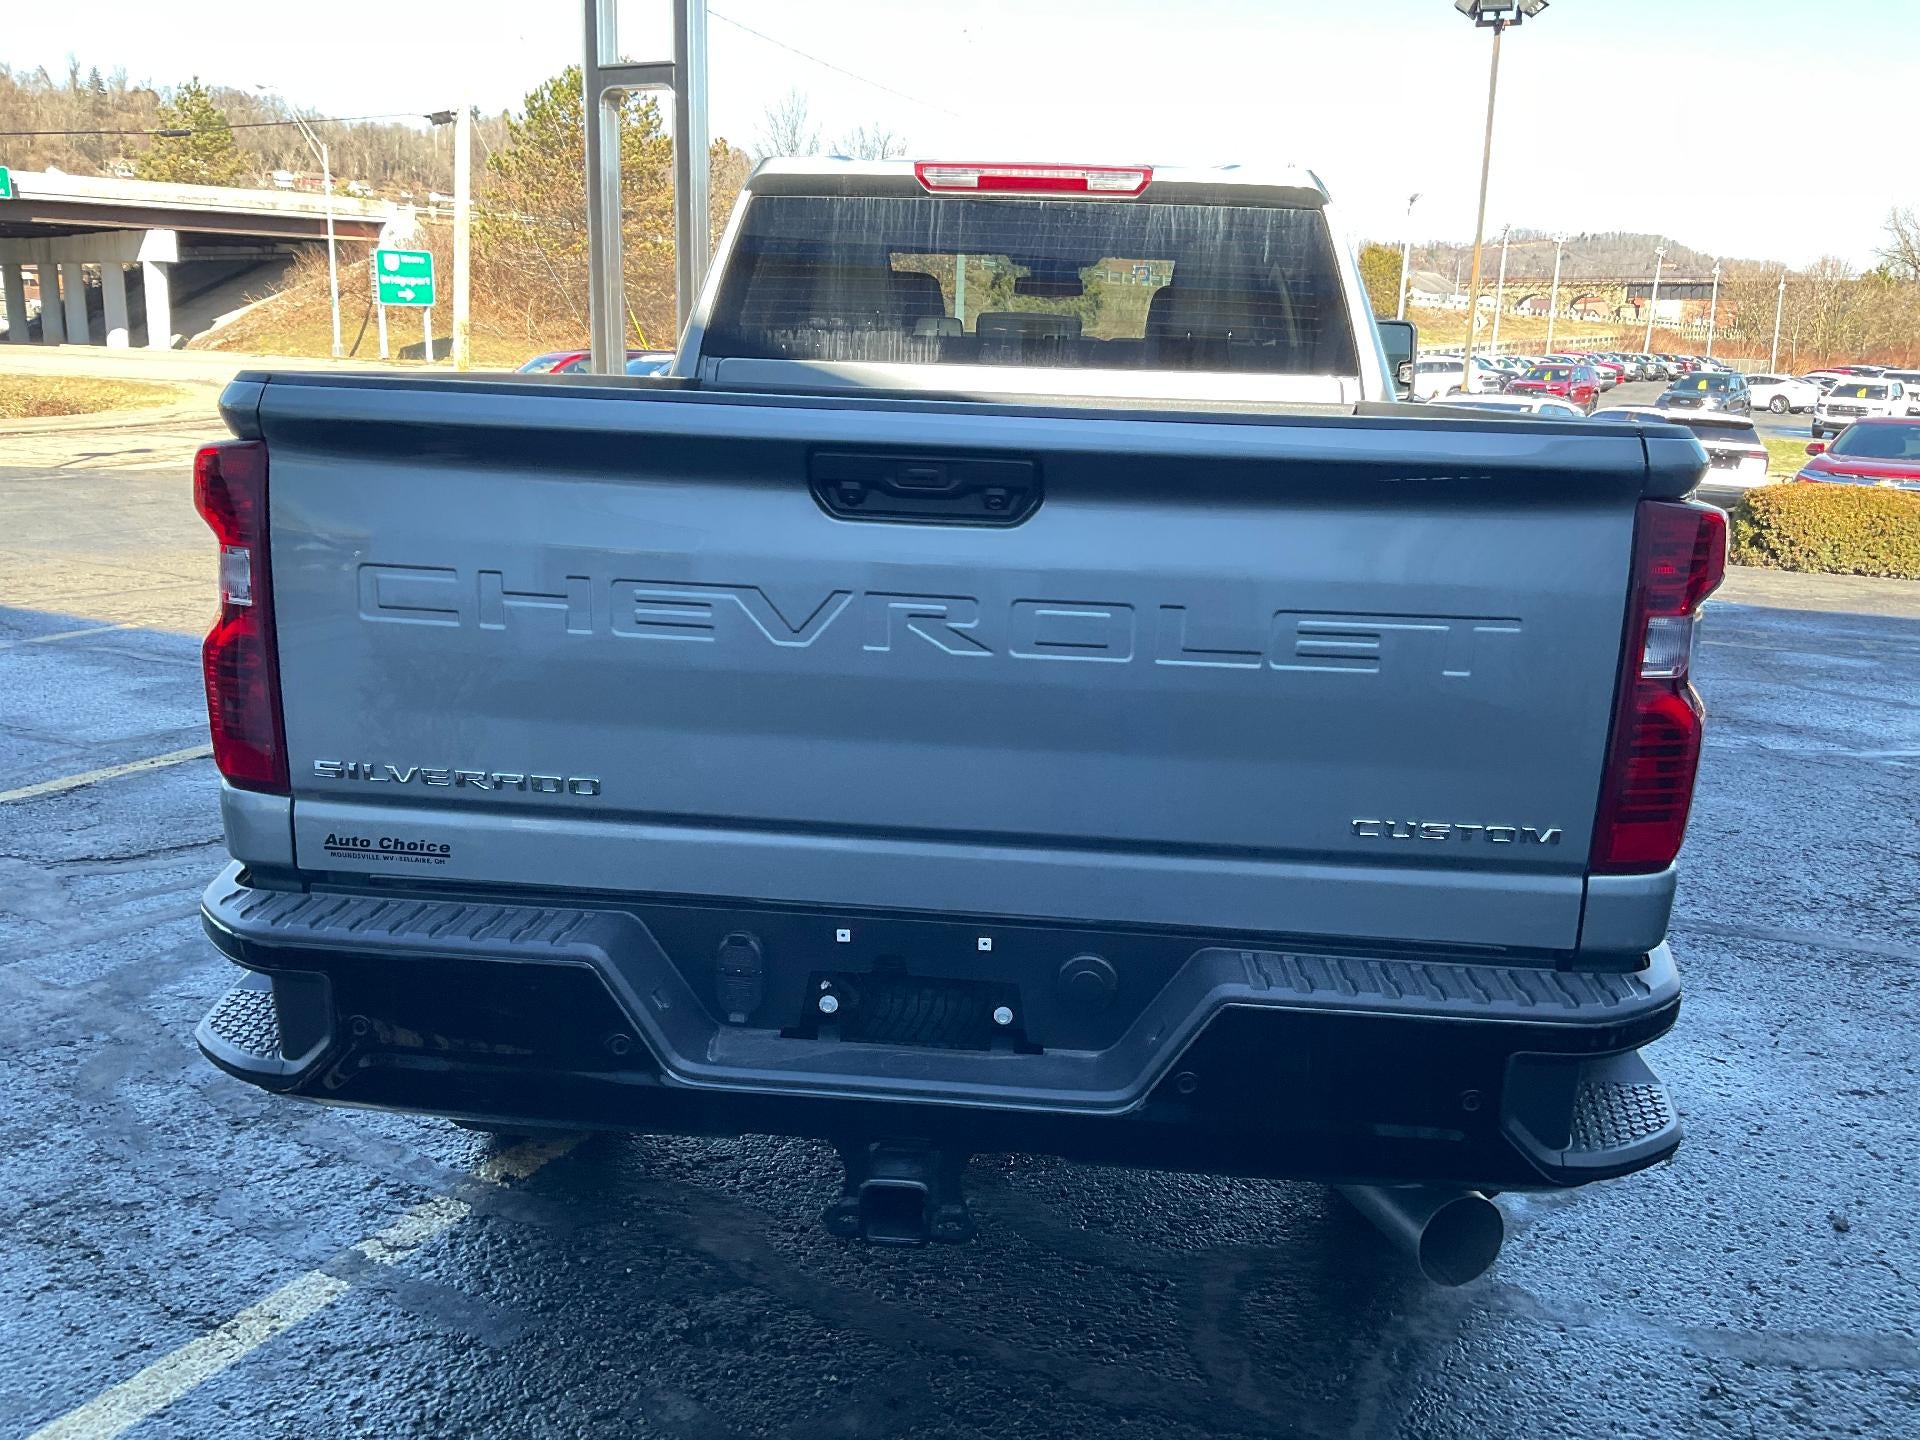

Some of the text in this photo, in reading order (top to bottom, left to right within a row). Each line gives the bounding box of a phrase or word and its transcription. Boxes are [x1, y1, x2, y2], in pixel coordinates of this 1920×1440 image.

[357, 563, 1524, 678] CHEVROLET
[313, 759, 601, 797] SILVERADO
[324, 833, 451, 854] Auto Choice
[1351, 818, 1563, 846] CUSTOM
